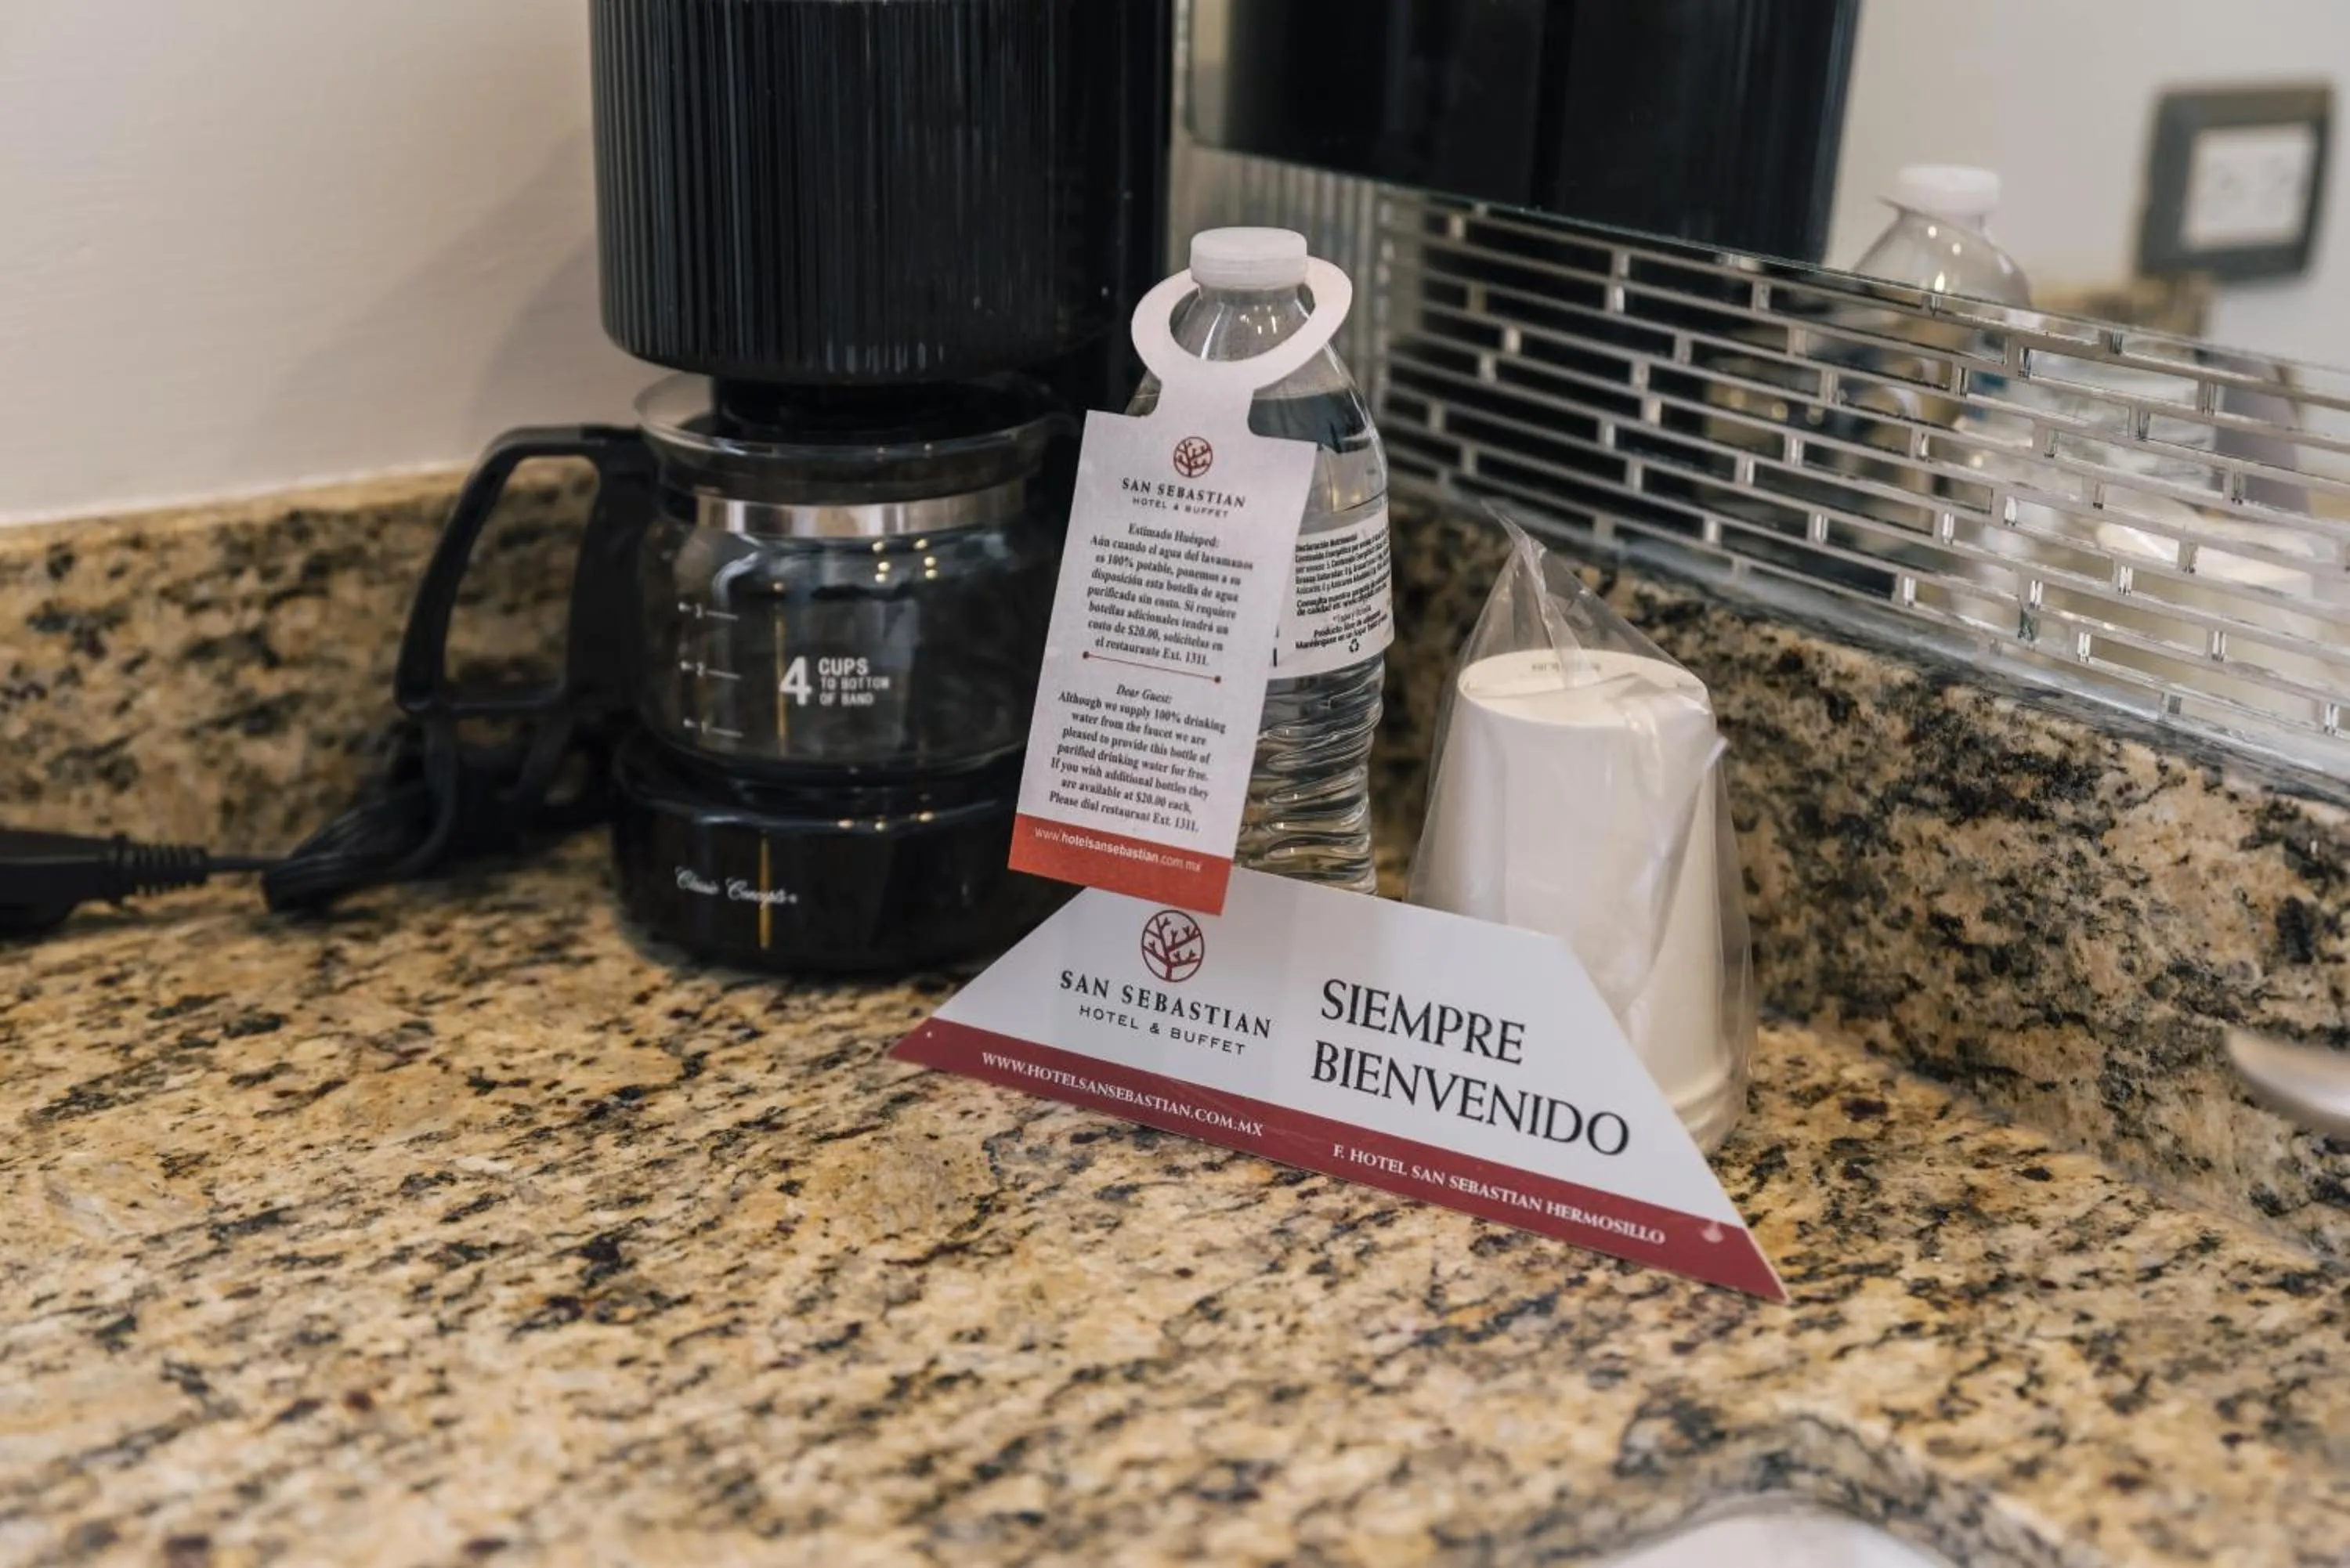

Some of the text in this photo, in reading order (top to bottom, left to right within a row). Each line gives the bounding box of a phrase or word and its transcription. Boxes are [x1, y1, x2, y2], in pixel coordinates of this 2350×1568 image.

[1122, 477, 1246, 508] SAN SEBASTIAN
[1132, 497, 1167, 509] HOTEL
[1184, 505, 1228, 518] BUFFET
[1127, 522, 1173, 540] Estimado
[1107, 554, 1133, 569] 100%
[1176, 568, 1220, 582] ponemos
[1112, 540, 1146, 553] cuando
[1148, 544, 1157, 555] el
[1159, 547, 1182, 560] agua
[1184, 549, 1199, 562] del
[1201, 551, 1253, 570] lavamanos
[1086, 586, 1137, 602] purificada
[1138, 594, 1152, 605] sin
[1184, 600, 1195, 612] Si
[1196, 605, 1236, 620] requiere
[1144, 579, 1165, 590] esta
[1166, 580, 1199, 596] botella
[1201, 587, 1213, 598] de
[1215, 591, 1238, 603] agua
[1087, 620, 1112, 632] costo
[1113, 622, 1126, 634] de
[1088, 600, 1126, 617] botellas
[1126, 609, 1179, 627] adicionales
[1094, 636, 1105, 648] el
[1105, 640, 1160, 657] restaurante
[779, 656, 812, 706] 4
[819, 657, 869, 676] CUPS
[820, 675, 890, 690] TO BOTTOM
[819, 692, 873, 706] OF BAND
[1115, 684, 1172, 704] Dear Guest:
[1058, 691, 1226, 734] Although we supply 100% drinking
[1071, 712, 1206, 746] water from the faucet we are
[1057, 743, 1096, 759] purified
[1097, 750, 1139, 770] drinking
[1141, 761, 1169, 773] water
[1171, 764, 1185, 776] for
[1061, 727, 1211, 764] pleased to provide this bottle of
[1050, 757, 1209, 798] If you wish additional bottles they
[1061, 779, 1077, 789] are
[1078, 782, 1122, 799] available
[1123, 791, 1133, 801] at
[1135, 791, 1166, 807] $20.00
[1049, 790, 1079, 807] Please
[1080, 797, 1099, 812] dial
[1101, 804, 1151, 822] restaurant
[1035, 828, 1202, 873] www.hotelsansebastian.com.mx
[1060, 970, 1271, 1039] SAN SEBASTIAN
[1079, 1004, 1246, 1055] HOTEL & BUFFET
[1321, 978, 1525, 1064] SIEMPRE
[982, 1052, 1264, 1137] WWW.HOTELSANSEBASTIAN.COM.MX
[1311, 1039, 1629, 1155] BIENVENIDO
[1333, 1144, 1665, 1244] F. HOTEL SAN SEBASTIAN HERMOSILLO
